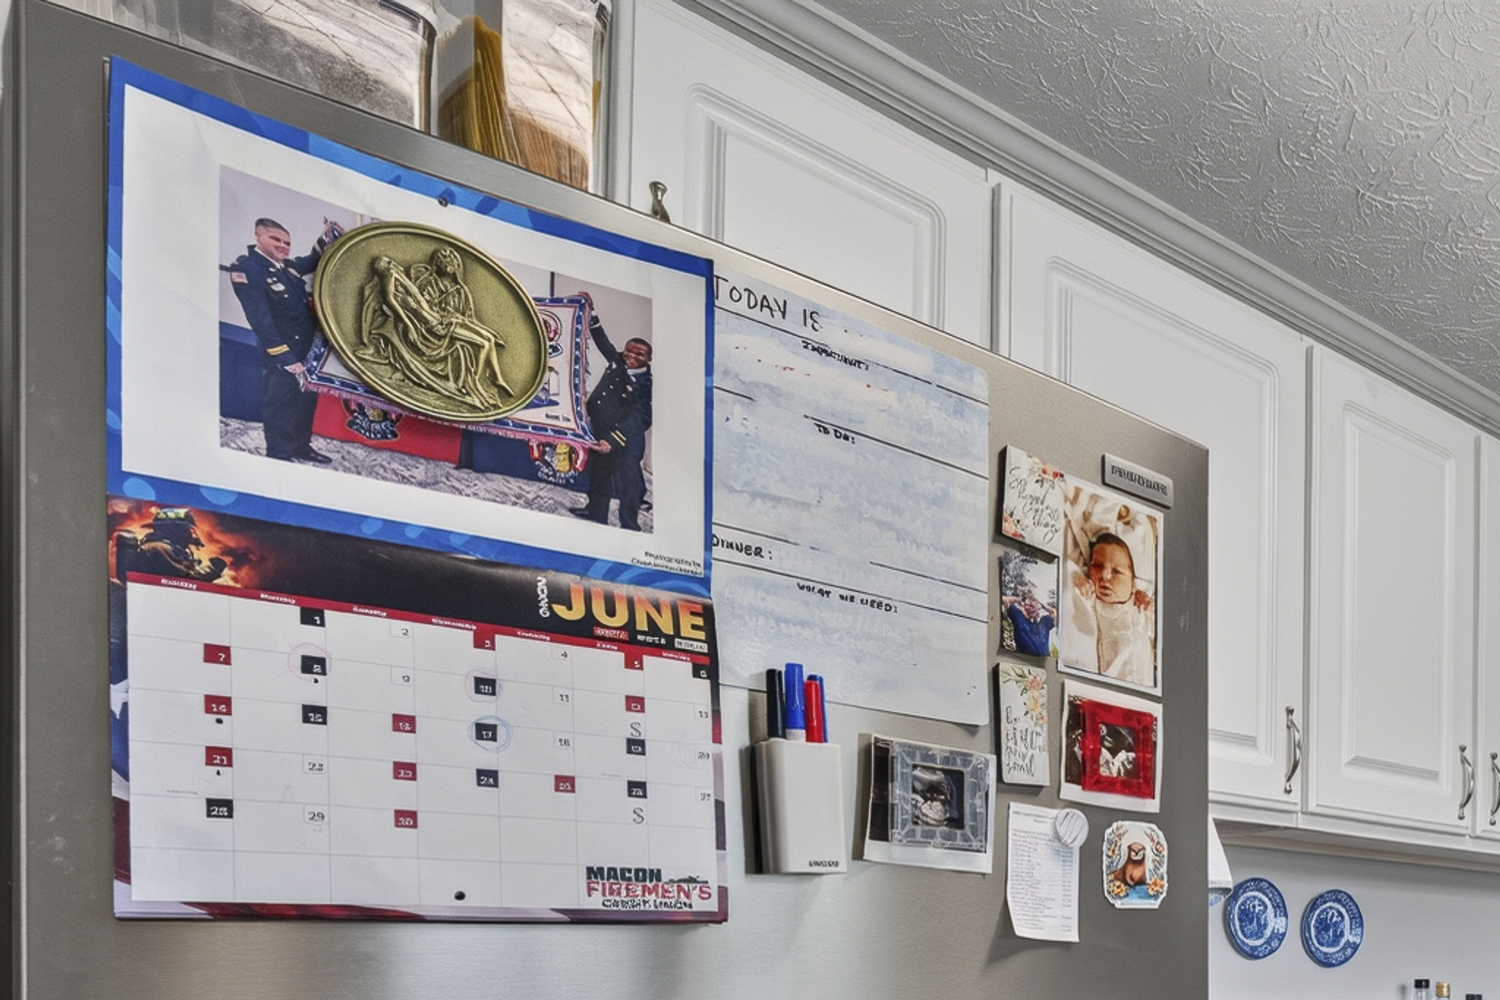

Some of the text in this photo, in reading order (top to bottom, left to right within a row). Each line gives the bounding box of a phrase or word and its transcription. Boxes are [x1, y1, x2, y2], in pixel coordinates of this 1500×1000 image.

[714, 275, 788, 320] TODAY
[552, 583, 706, 641] JUNE
[585, 866, 663, 883] MACON
